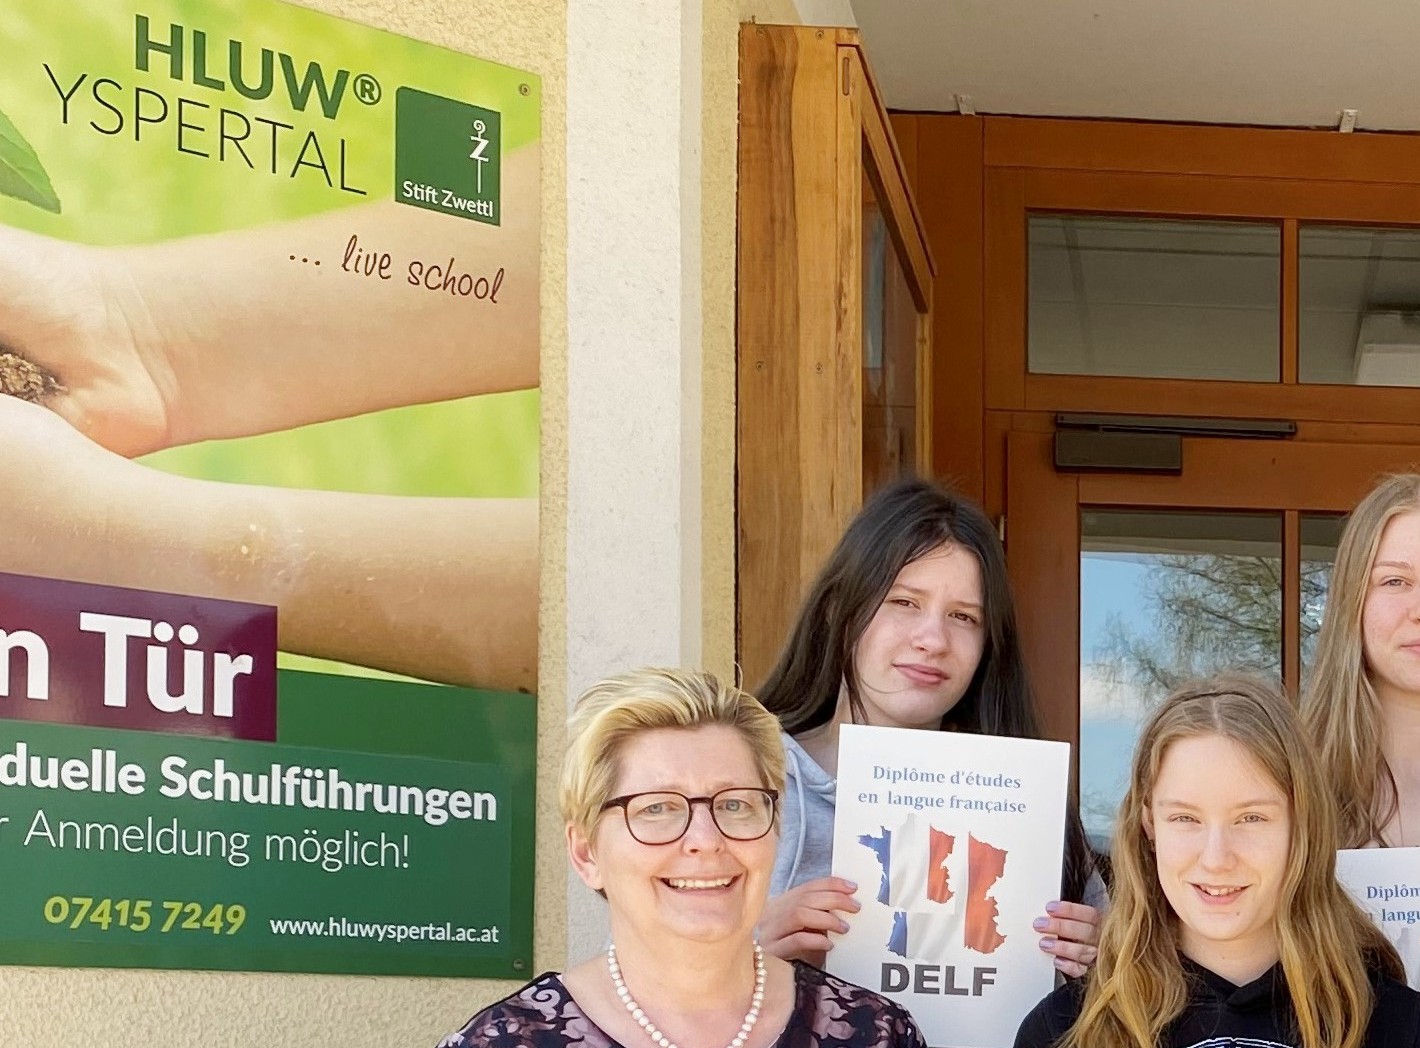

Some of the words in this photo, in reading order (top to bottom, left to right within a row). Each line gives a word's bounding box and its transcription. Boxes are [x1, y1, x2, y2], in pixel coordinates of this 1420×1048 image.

[42, 63, 367, 196] YSPERTAL
[402, 180, 439, 205] Stift
[441, 189, 494, 218] Zwettl
[341, 234, 392, 280] live
[407, 257, 505, 304] school
[79, 611, 253, 718] Tür
[0, 742, 146, 795] duelle
[159, 756, 497, 826] Schulführungen
[857, 791, 879, 804] en
[887, 791, 945, 811] langue
[949, 794, 1027, 814] française
[873, 765, 946, 785] Diplôme
[23, 809, 250, 867] Anmeldung
[265, 828, 410, 873] möglich!
[44, 896, 152, 933] 07415
[161, 901, 246, 936] 7249
[270, 914, 499, 944] www.hluwyspertal.ac.at
[880, 962, 998, 997] DELF
